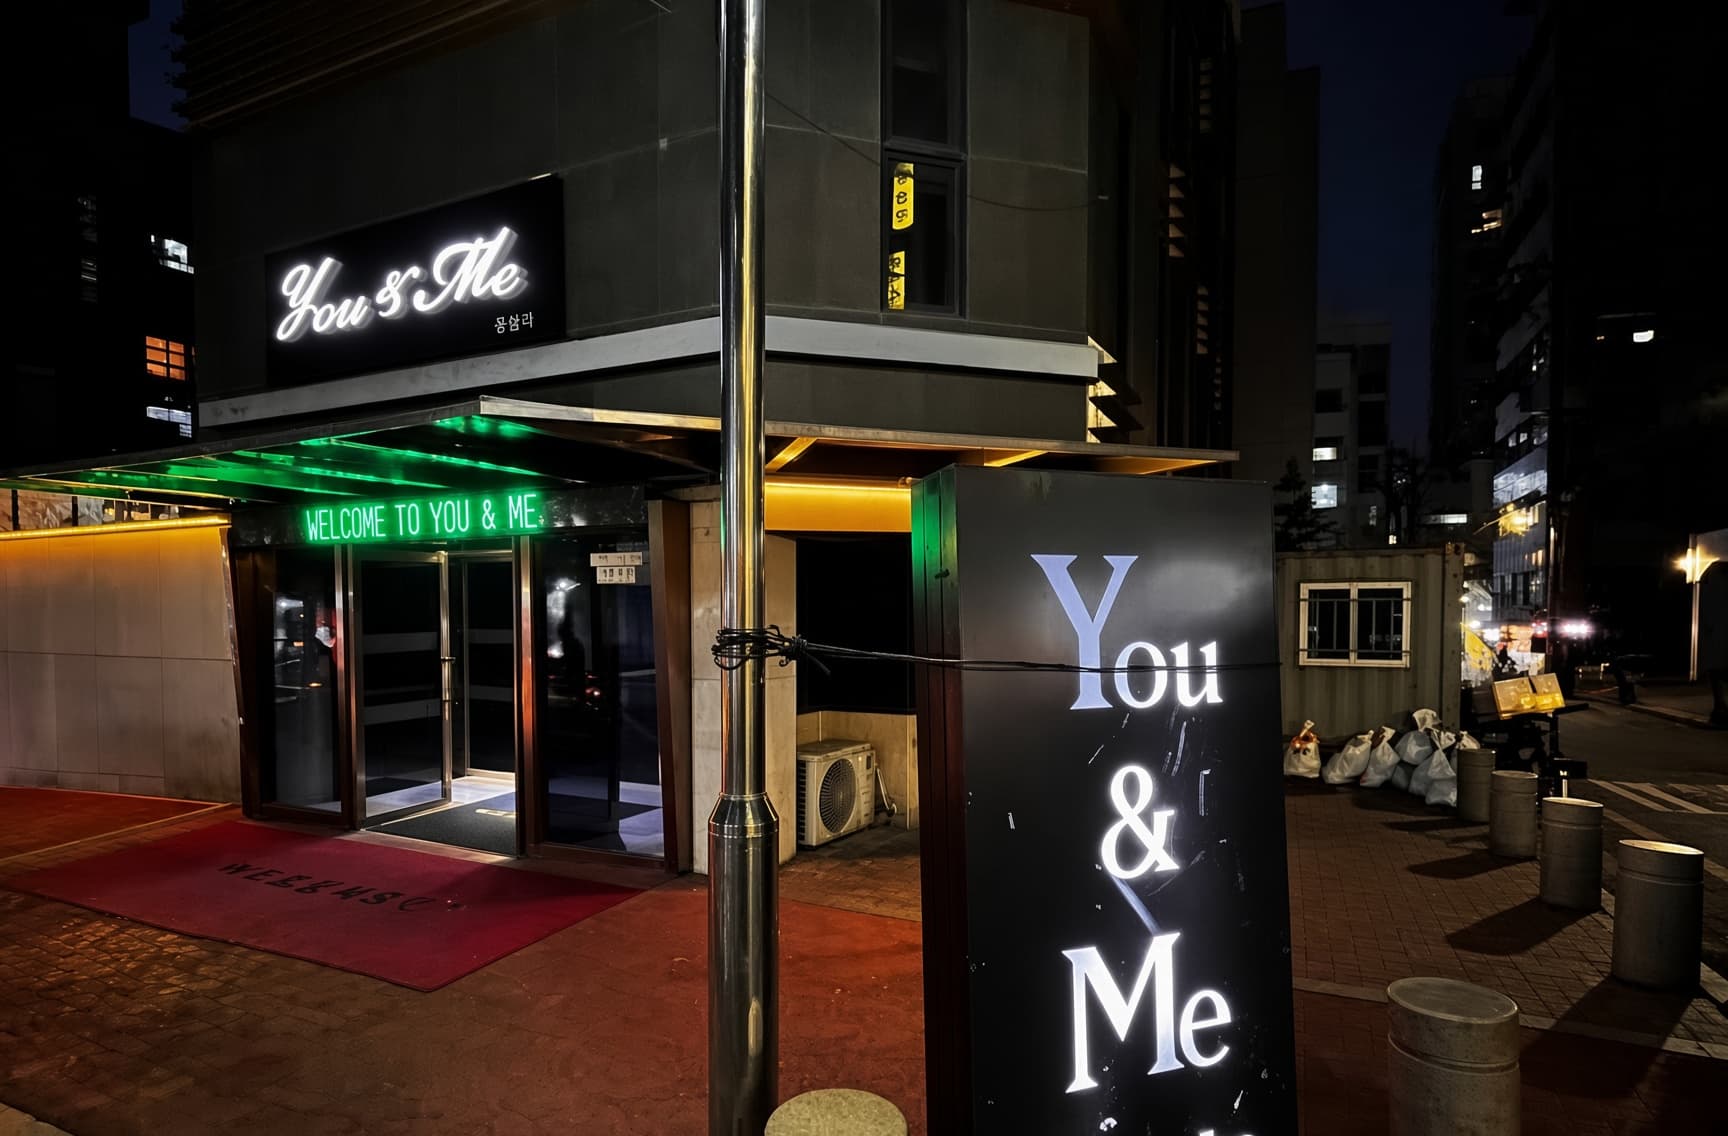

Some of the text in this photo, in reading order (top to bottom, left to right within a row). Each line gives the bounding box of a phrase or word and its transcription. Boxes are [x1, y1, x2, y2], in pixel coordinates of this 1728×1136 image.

[276, 226, 528, 342] You & Me
[305, 493, 538, 541] WELCOME TO YOU & ME
[1030, 553, 1223, 711] You
[1100, 764, 1181, 881] &
[1061, 932, 1233, 1095] Me
